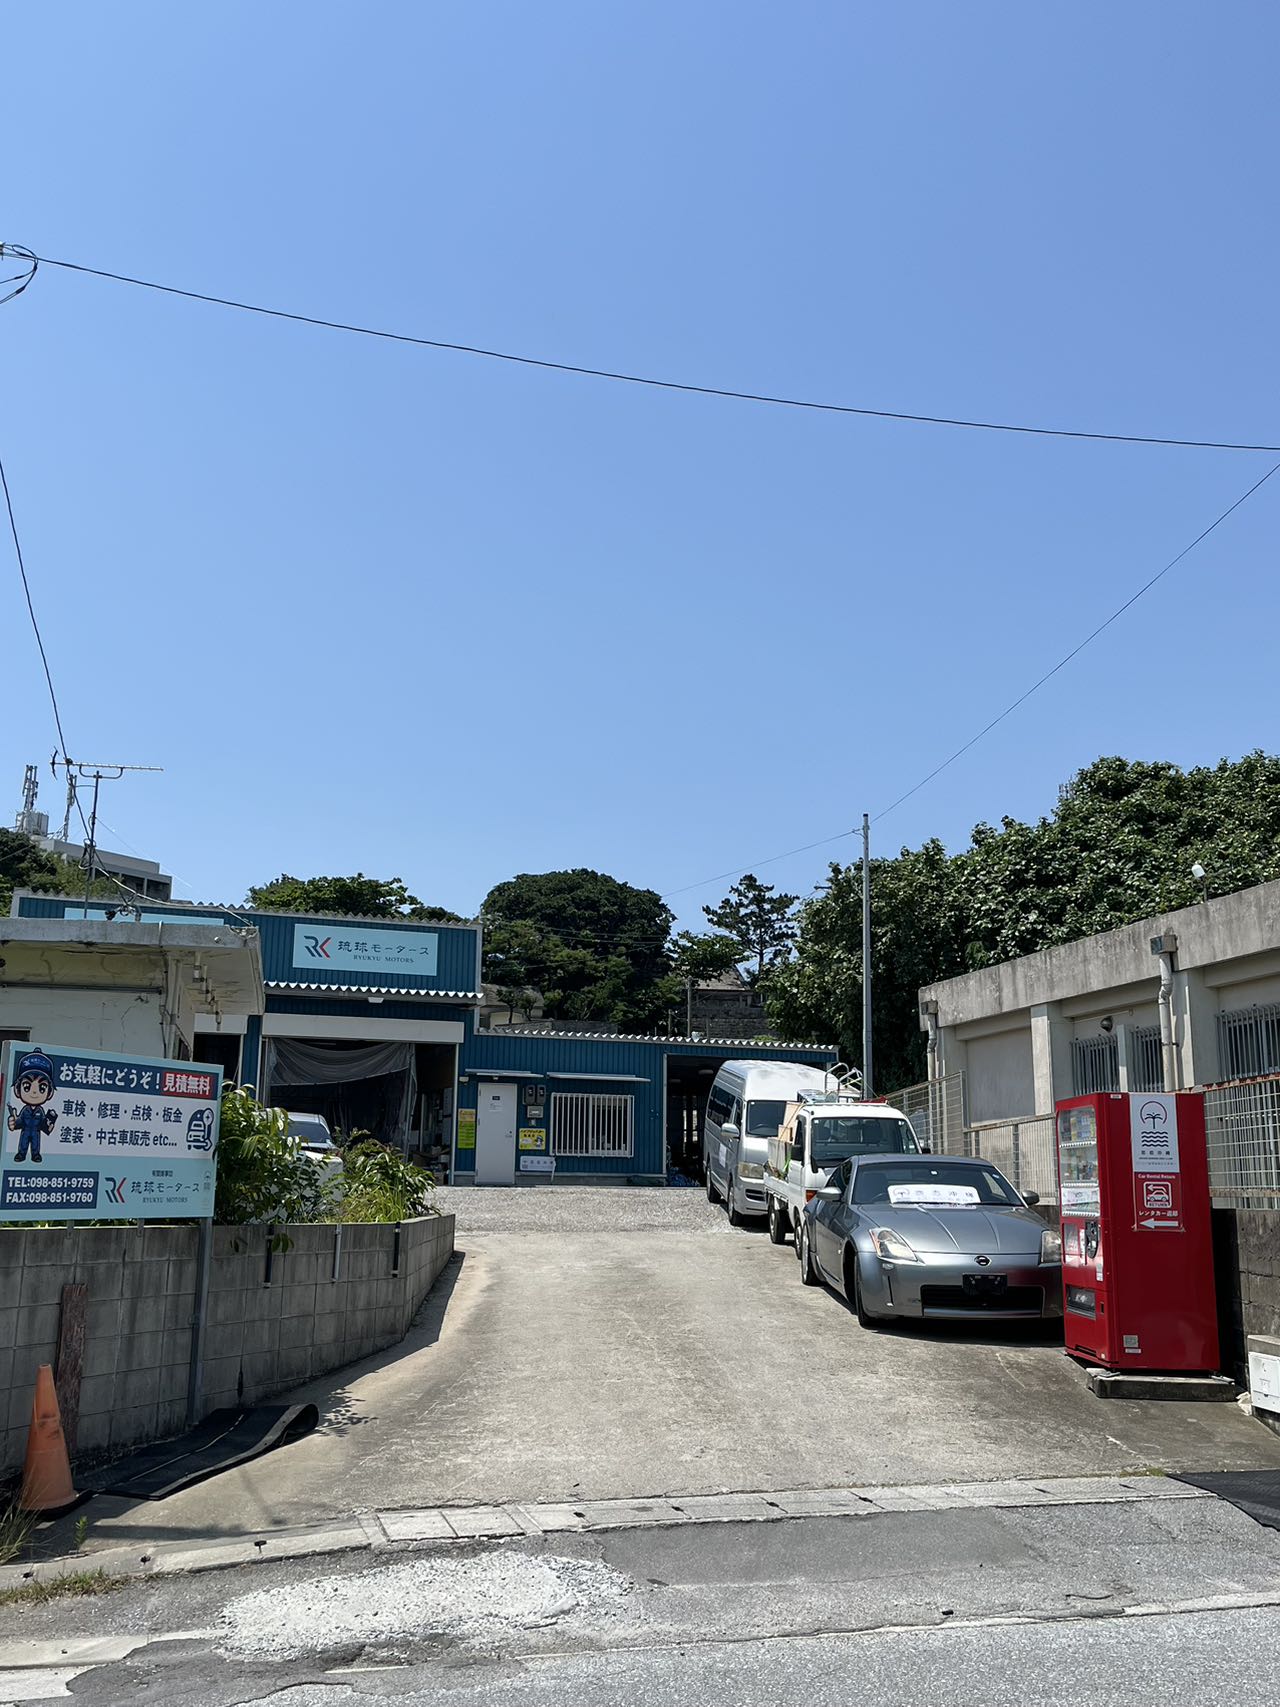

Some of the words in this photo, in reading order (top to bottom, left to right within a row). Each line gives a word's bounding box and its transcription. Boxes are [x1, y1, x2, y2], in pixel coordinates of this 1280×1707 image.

[338, 941, 429, 955] 琉球モータース
[163, 1073, 210, 1095] 見積無料
[131, 1181, 200, 1194] 琉球モータース
